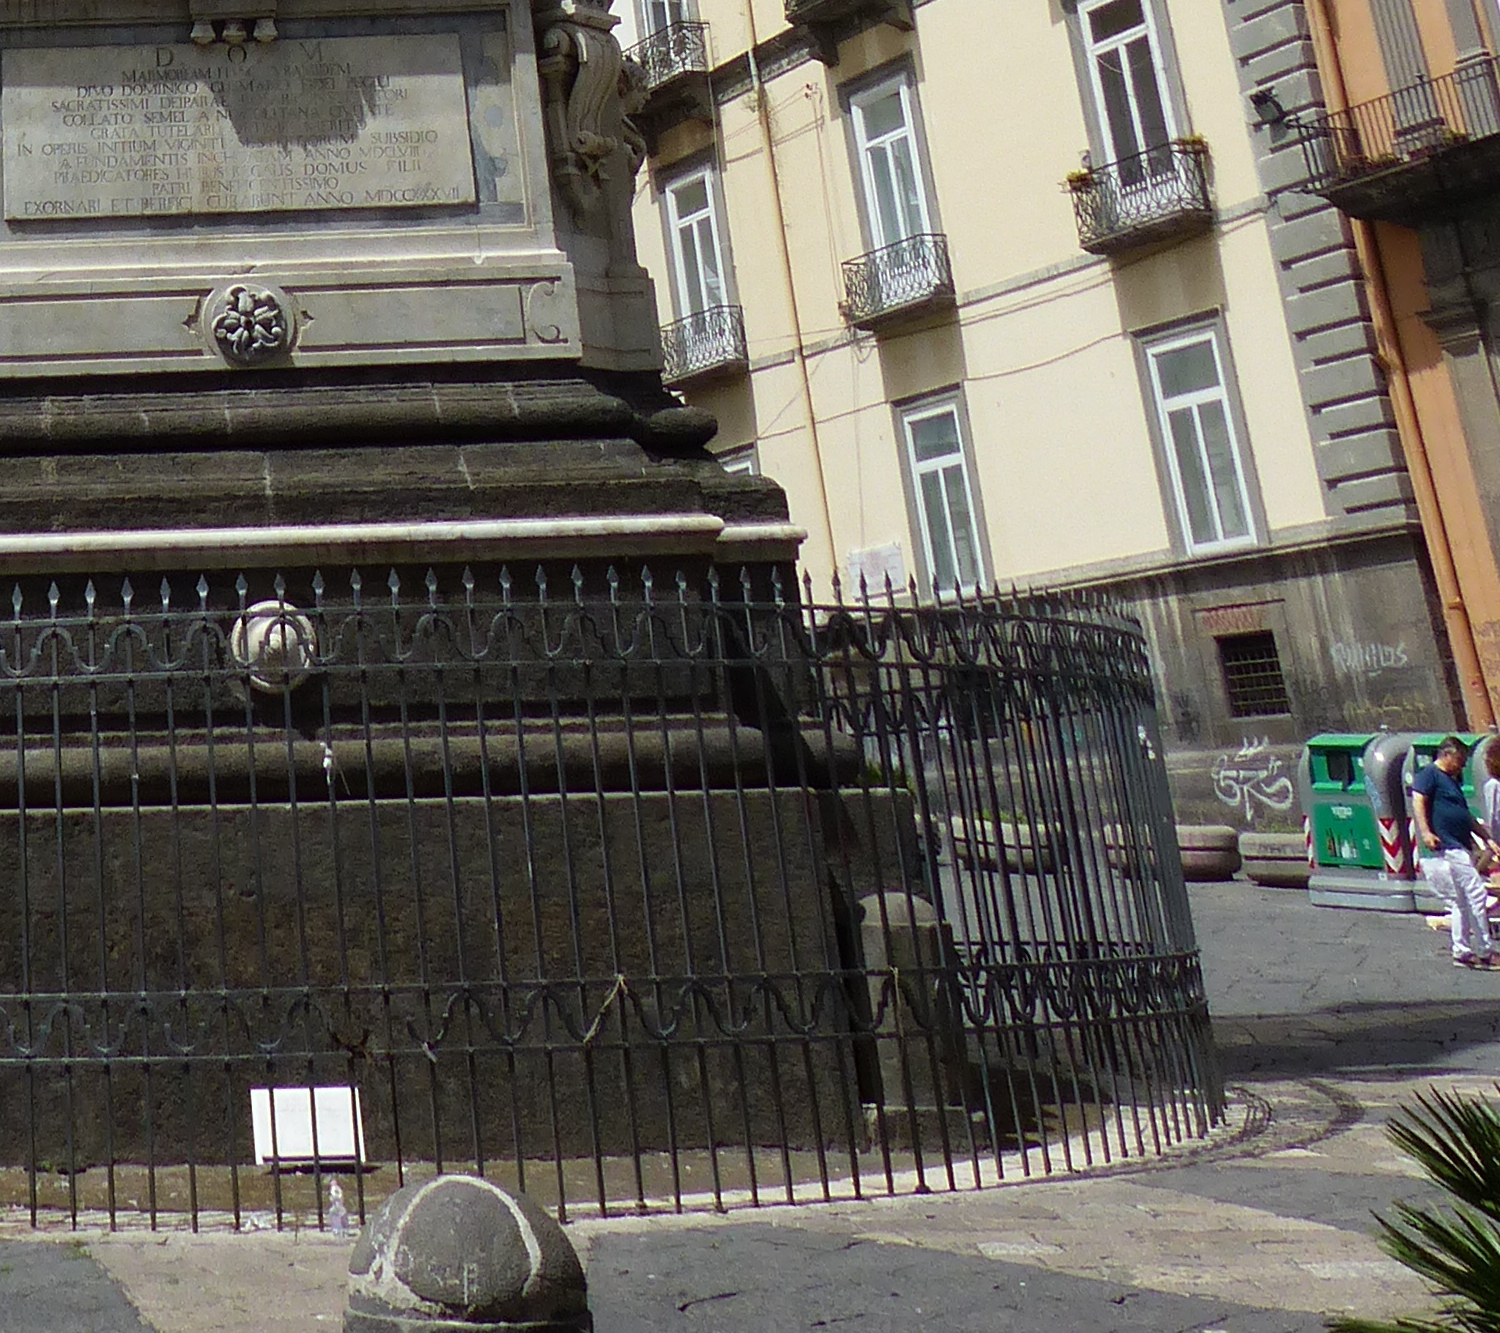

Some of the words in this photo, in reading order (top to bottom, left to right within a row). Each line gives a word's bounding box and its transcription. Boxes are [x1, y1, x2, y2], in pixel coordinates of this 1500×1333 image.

[156, 47, 174, 67] D
[227, 44, 247, 63] O
[77, 84, 113, 98] DIVO
[121, 82, 198, 96] DOMINICO
[51, 96, 150, 113] SACRATISSIMI
[62, 111, 133, 127] COLLATO
[143, 110, 187, 124] SEMEL
[197, 110, 210, 122] A
[90, 126, 140, 140] GRATA
[148, 124, 216, 138] TUTELARI
[17, 143, 33, 157] IN
[41, 141, 88, 156] OPERIS
[97, 140, 156, 153] INITIUM
[165, 138, 225, 152] VIGINTI
[370, 129, 438, 145] SUBSIDIO
[76, 153, 188, 169] FUNDAMENTIS
[304, 147, 351, 161] ANNO
[54, 168, 169, 184] PRAEDICATORES
[303, 161, 367, 177] DOMUS
[152, 181, 191, 196] PATRI
[23, 198, 101, 215] EXORNARI
[111, 198, 136, 212] ET
[304, 191, 354, 206] ANNO
